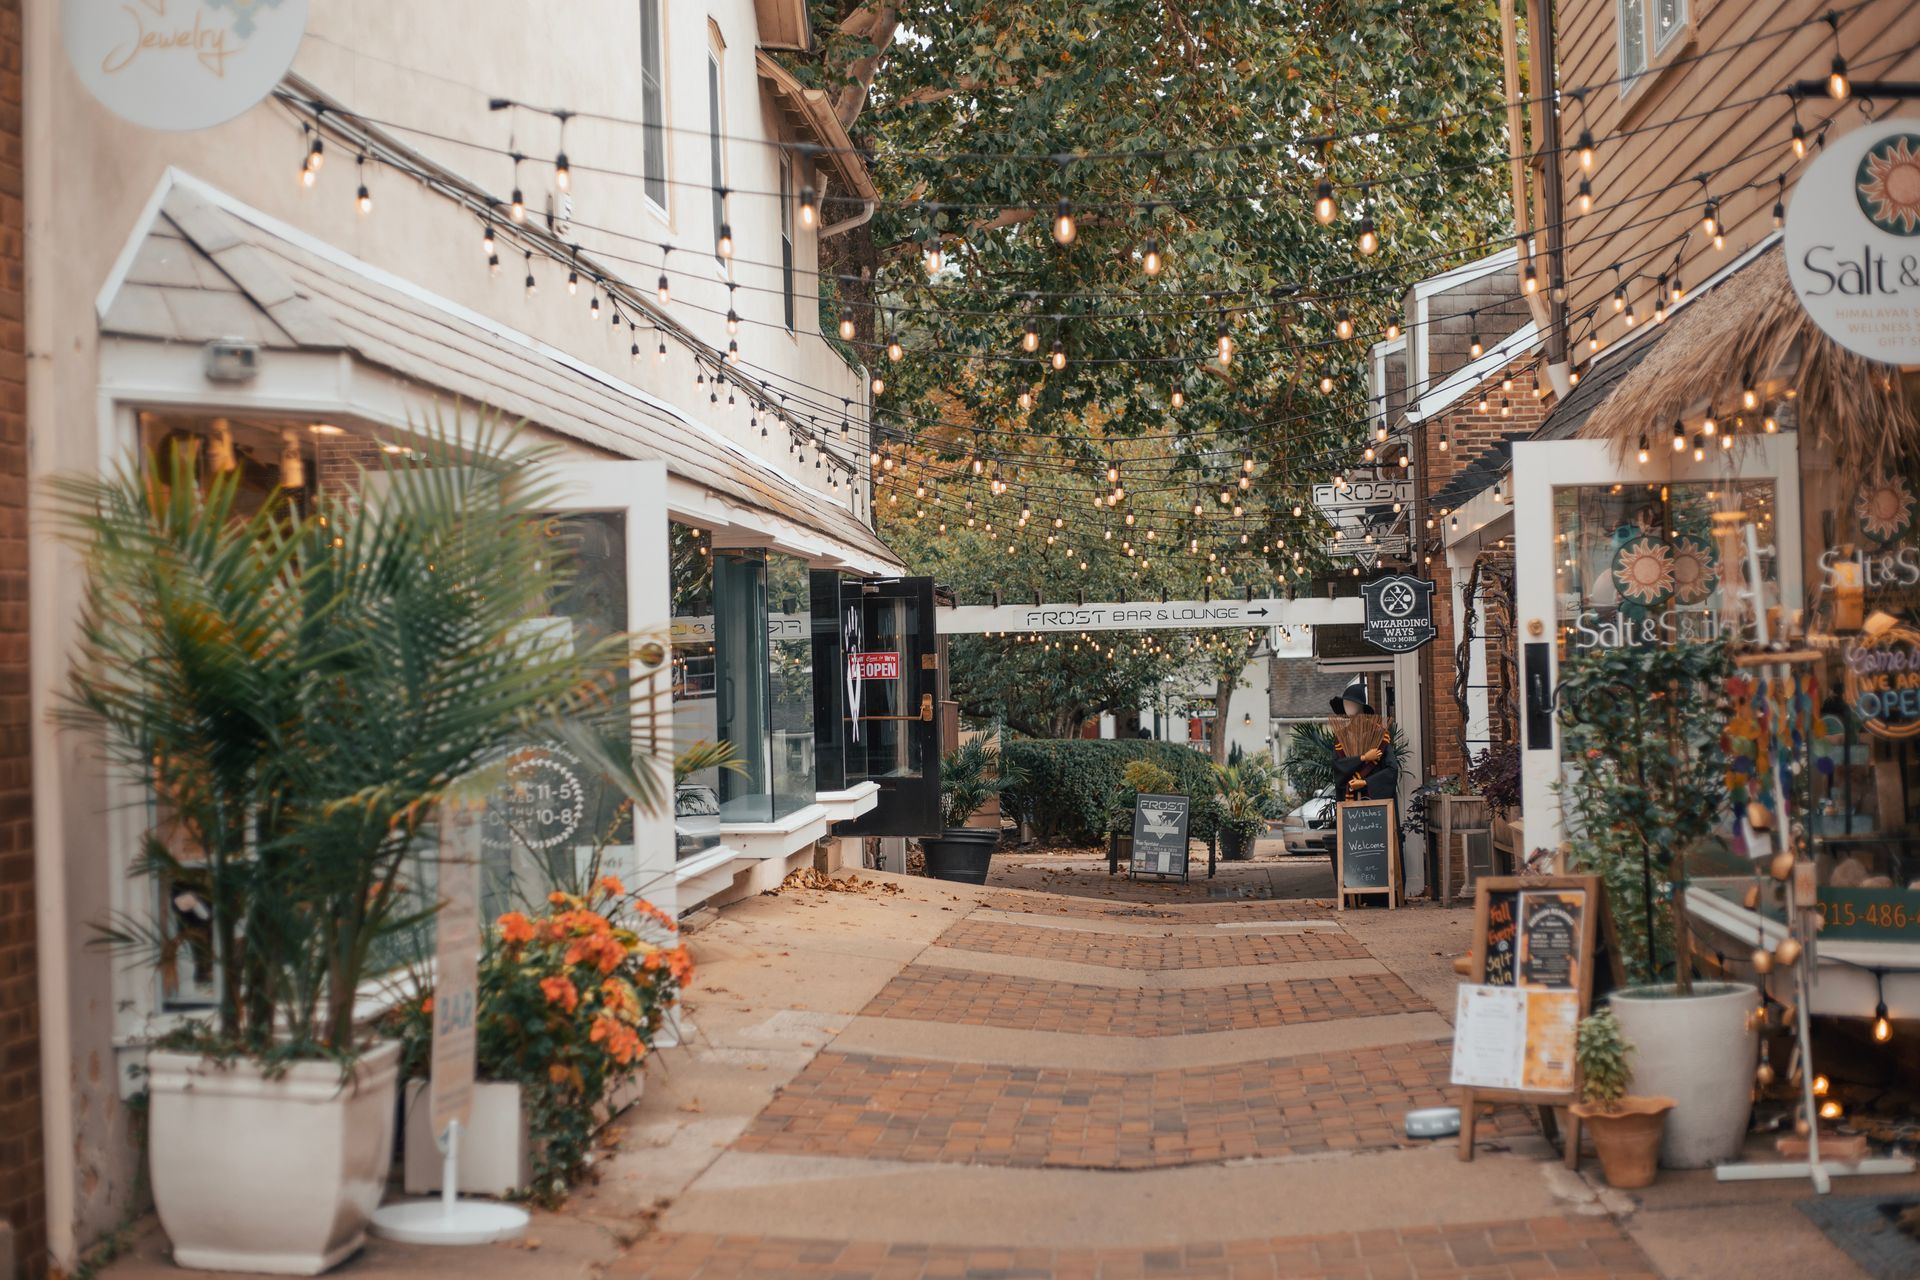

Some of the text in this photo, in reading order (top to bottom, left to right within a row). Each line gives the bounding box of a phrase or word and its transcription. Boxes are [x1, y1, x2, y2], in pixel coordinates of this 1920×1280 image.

[102, 4, 243, 79] Jewelry
[1803, 244, 1898, 295] Salt
[1836, 308, 1909, 319] HIMALAYAN
[1848, 323, 1911, 333] WELLNESS
[1879, 338, 1905, 348] GIFT
[1315, 481, 1412, 503] FROST
[1881, 555, 1897, 581] &
[1027, 607, 1239, 626] FROST BAR & LOUNGE
[1370, 618, 1428, 629] WIZARDING
[1384, 627, 1415, 637] WAYS
[1575, 612, 1642, 648] Salt
[1641, 618, 1659, 642] &
[866, 662, 896, 677] OPEN
[1860, 674, 1891, 691] WE
[537, 784, 572, 800] 11-5
[1140, 800, 1186, 811] FROST
[536, 808, 573, 825] 10-8
[1348, 809, 1382, 820] Witches
[1348, 840, 1386, 851] Welcome
[1487, 951, 1513, 972] Salt
